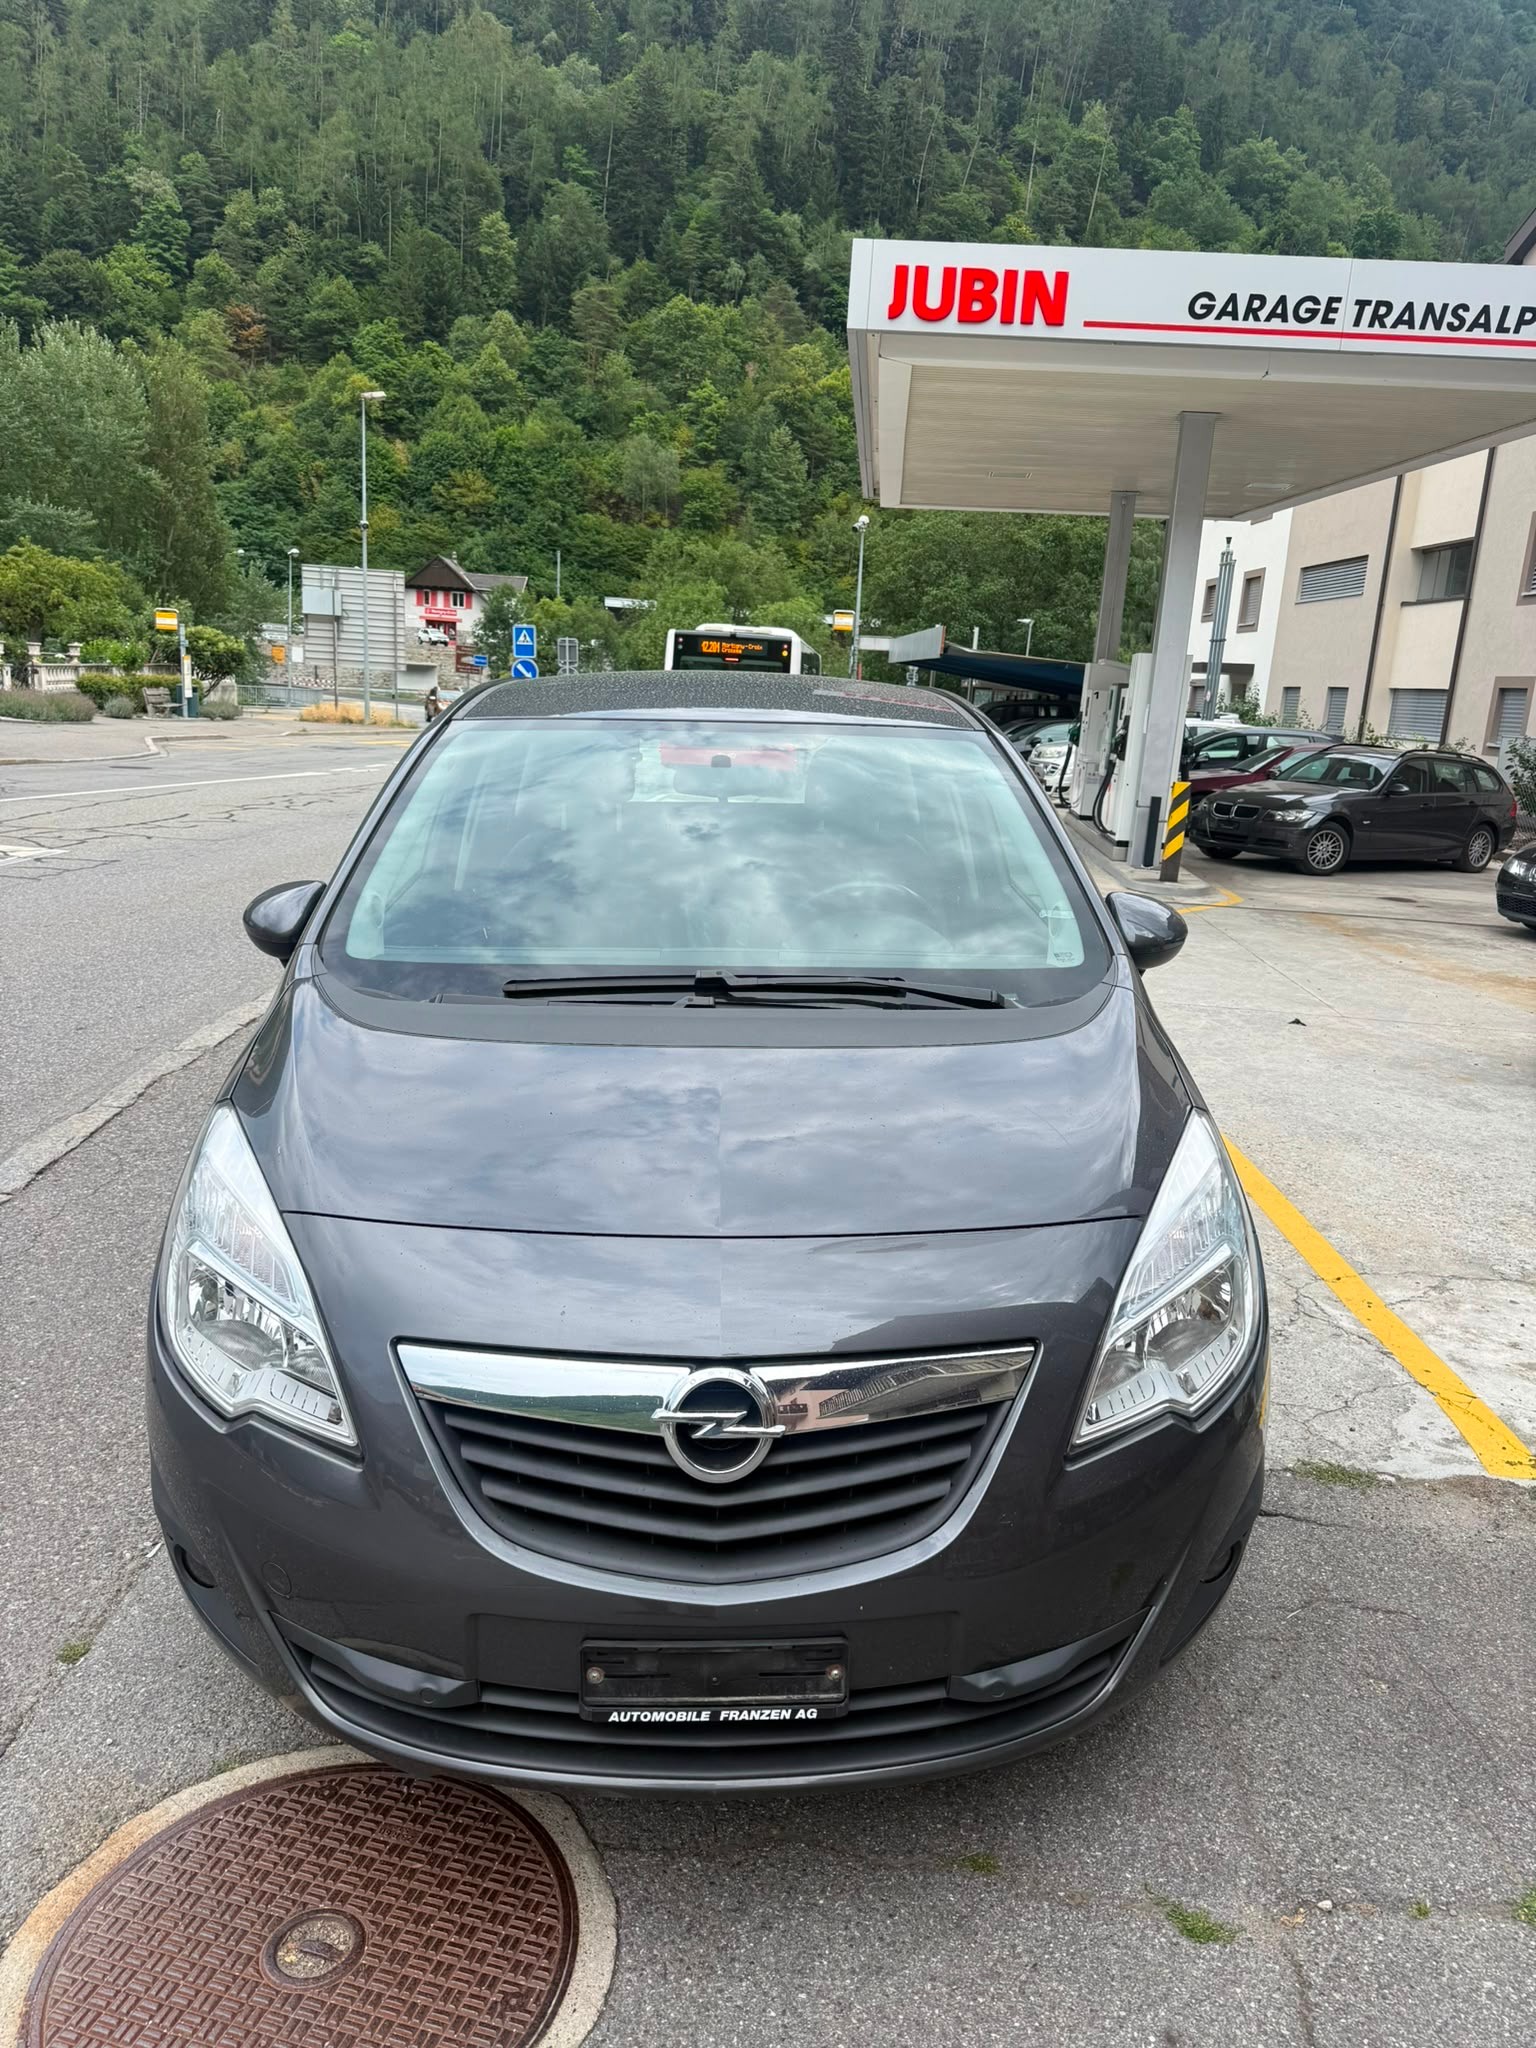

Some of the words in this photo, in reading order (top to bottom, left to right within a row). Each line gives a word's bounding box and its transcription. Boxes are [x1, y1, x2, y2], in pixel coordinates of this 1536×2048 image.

[888, 264, 1070, 327] JUBIN
[1187, 290, 1342, 325] GARAGE
[1352, 299, 1536, 334] TRANSALP
[1093, 691, 1099, 699] 1
[608, 1711, 711, 1723] AUTOMOBILE
[719, 1709, 792, 1721] FRANZEN
[795, 1708, 818, 1720] AG
